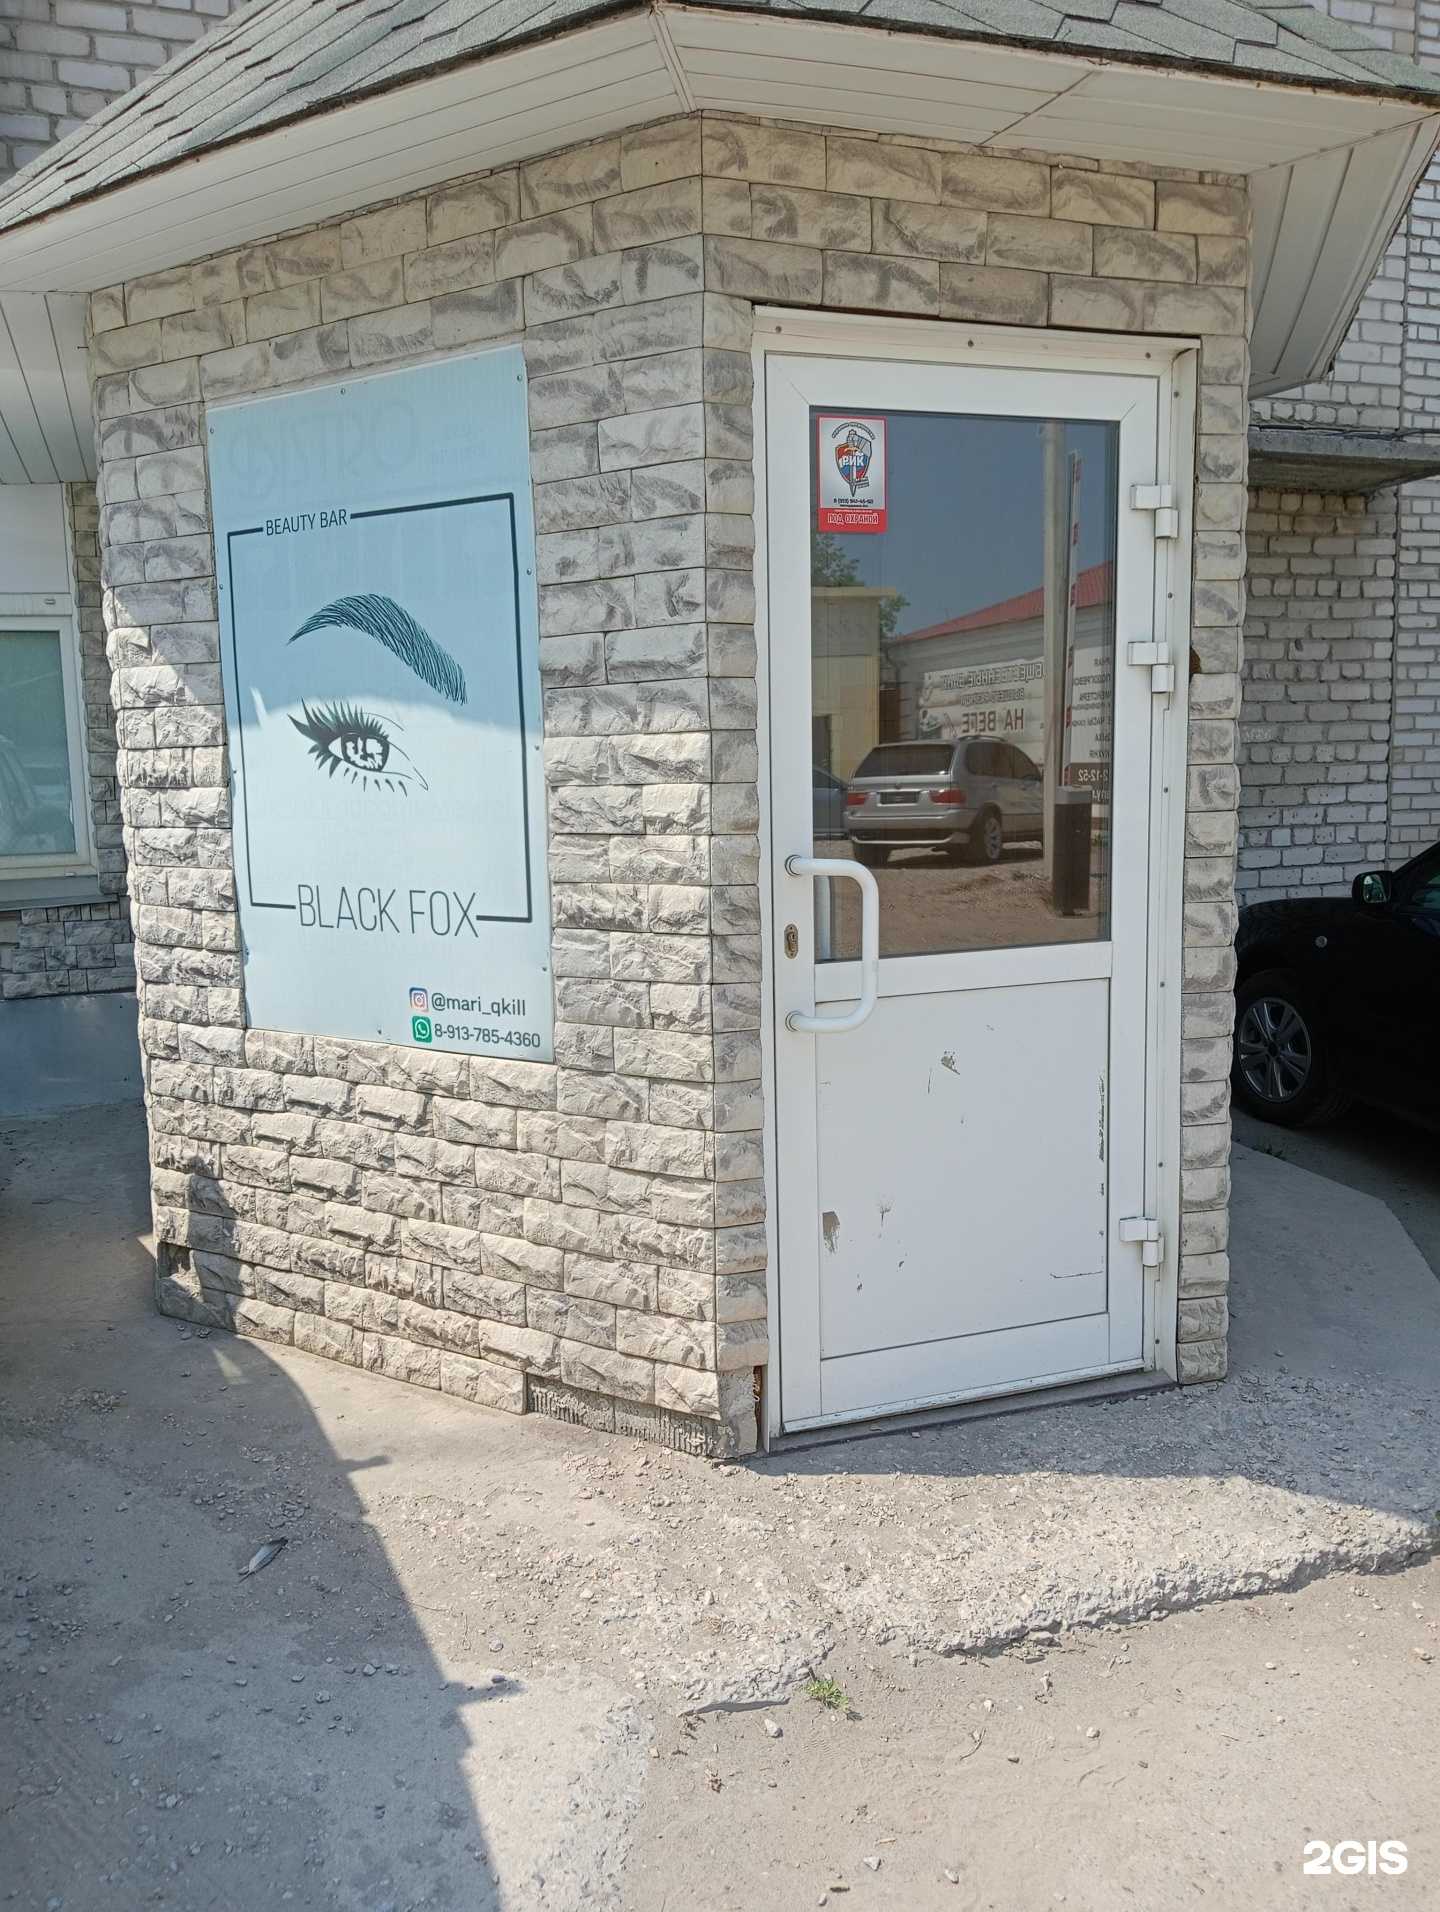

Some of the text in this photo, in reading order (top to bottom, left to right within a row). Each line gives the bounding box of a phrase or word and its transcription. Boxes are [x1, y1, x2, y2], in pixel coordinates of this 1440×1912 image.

[266, 509, 347, 536] BEAUTY BAR
[298, 884, 479, 938] BLACK FOX
[431, 992, 526, 1017] @mari_qkill
[434, 1023, 541, 1048] 8-913-785-4360
